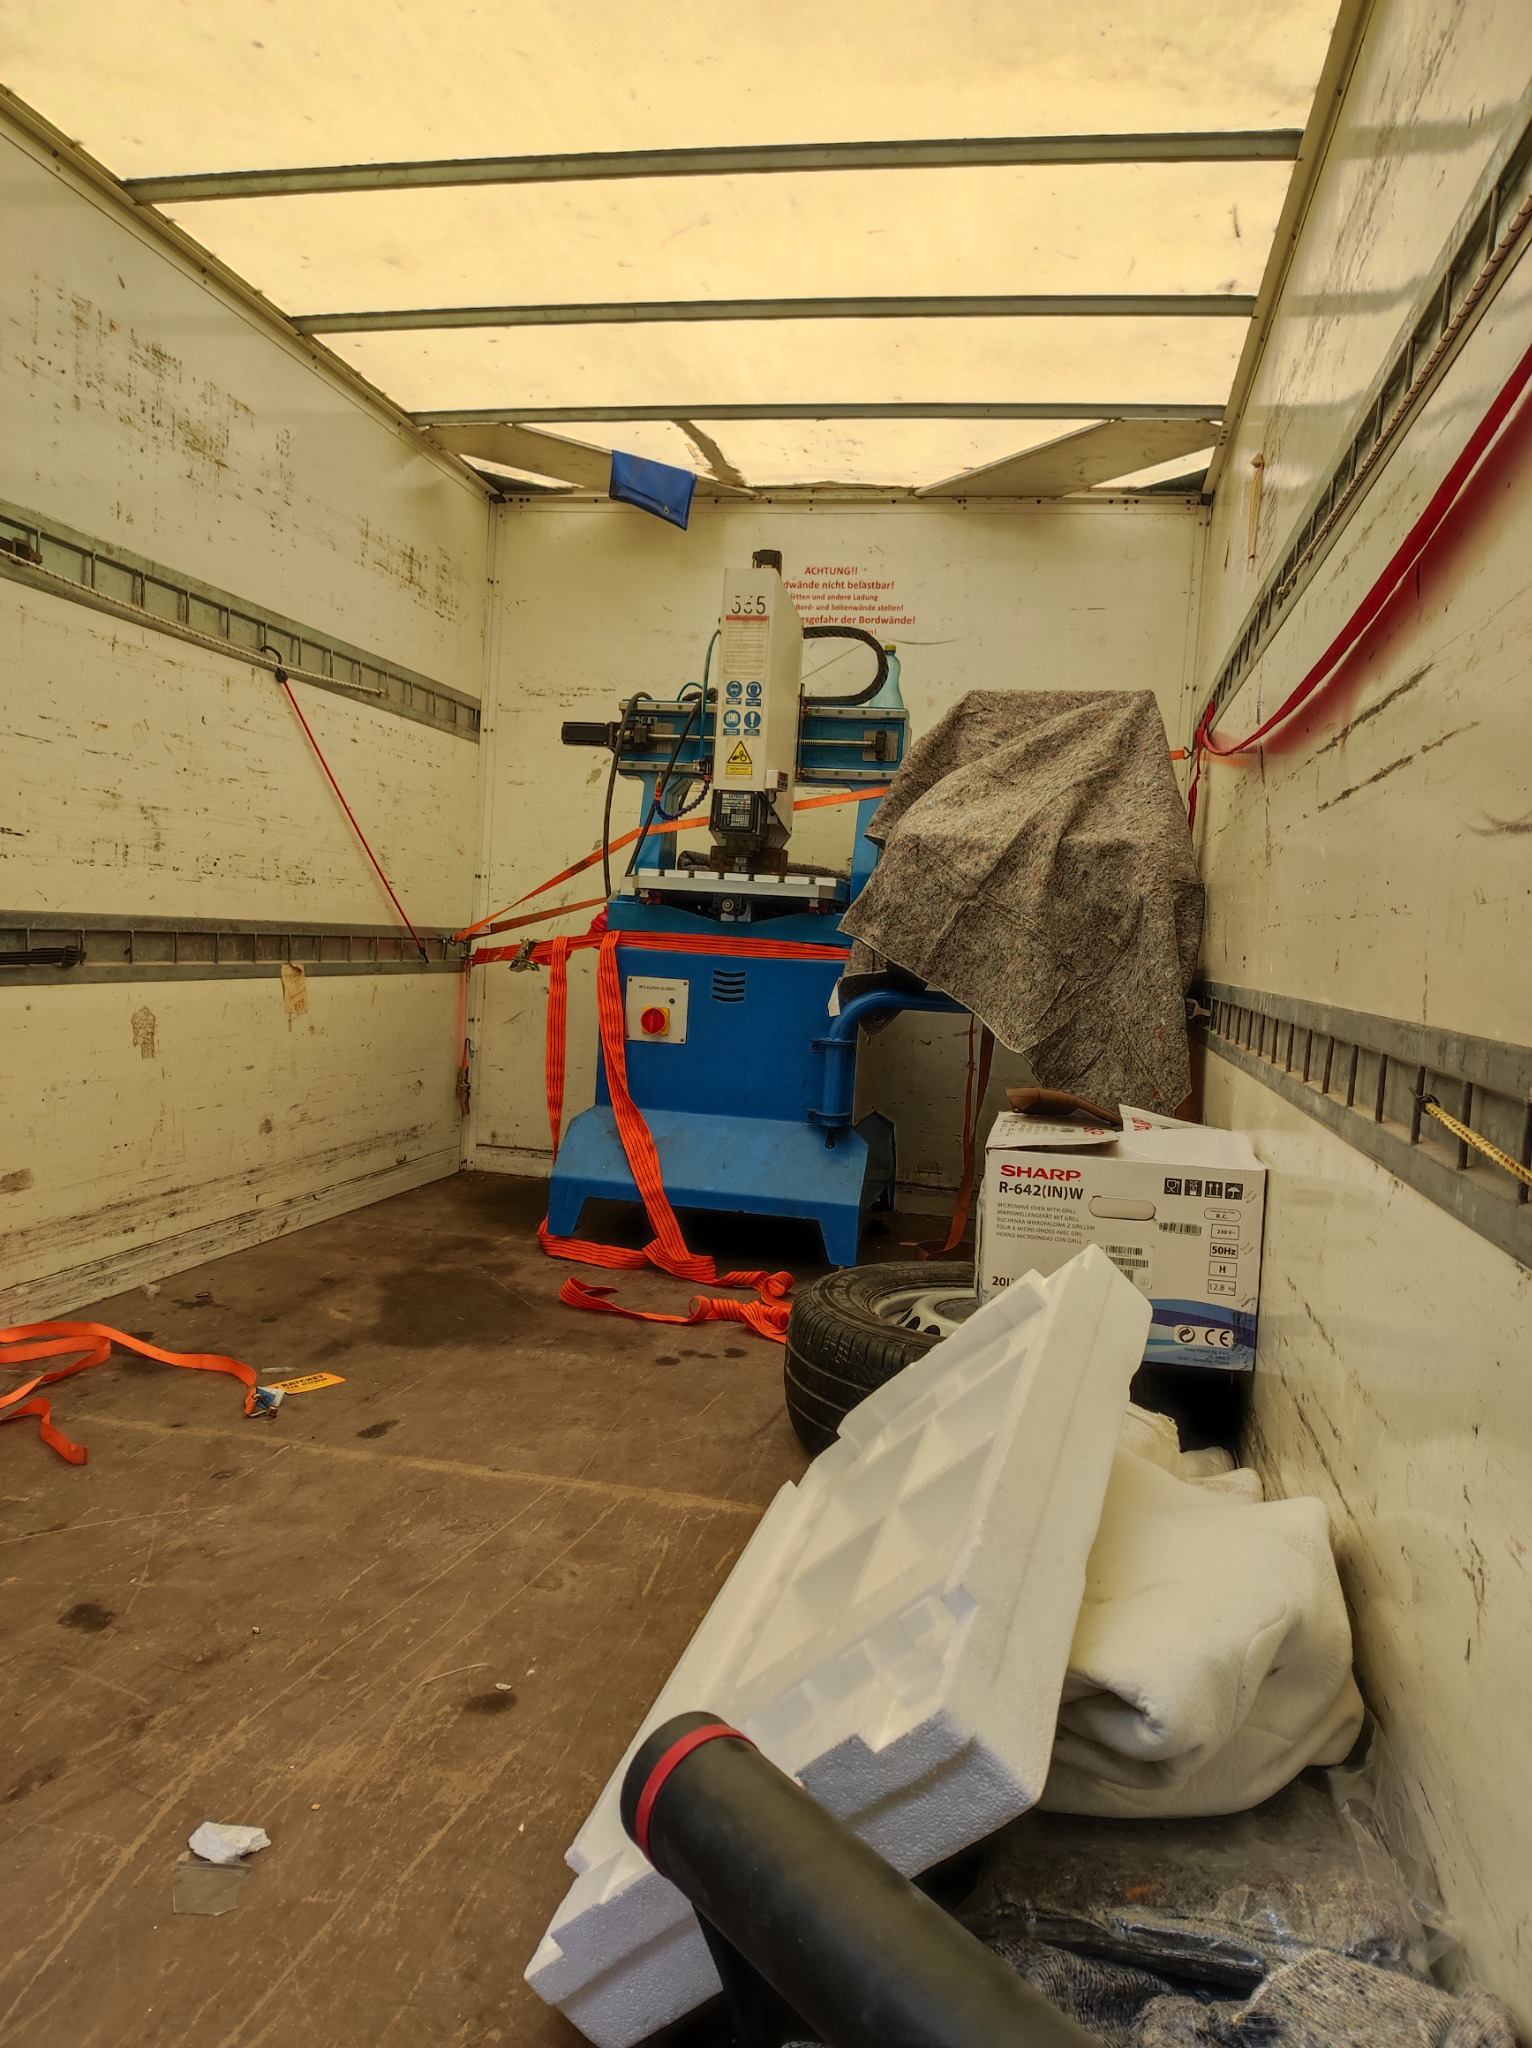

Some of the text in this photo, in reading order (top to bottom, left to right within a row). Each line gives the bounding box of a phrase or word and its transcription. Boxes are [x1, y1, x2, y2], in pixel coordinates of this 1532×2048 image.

[804, 566, 858, 575] ACHTUNG!!
[784, 580, 894, 589] dwände nicht belastbar!
[853, 594, 878, 602] Ladung
[841, 616, 857, 624] der
[859, 616, 916, 625] Bordwände!
[1000, 1164, 1081, 1181] SHARP
[999, 1181, 1084, 1200] R-642(IN)W
[1212, 1246, 1236, 1256] 50Hz
[1219, 1266, 1226, 1274] H
[1209, 1283, 1225, 1291] 12.8
[281, 1375, 324, 1387] RATCHET
